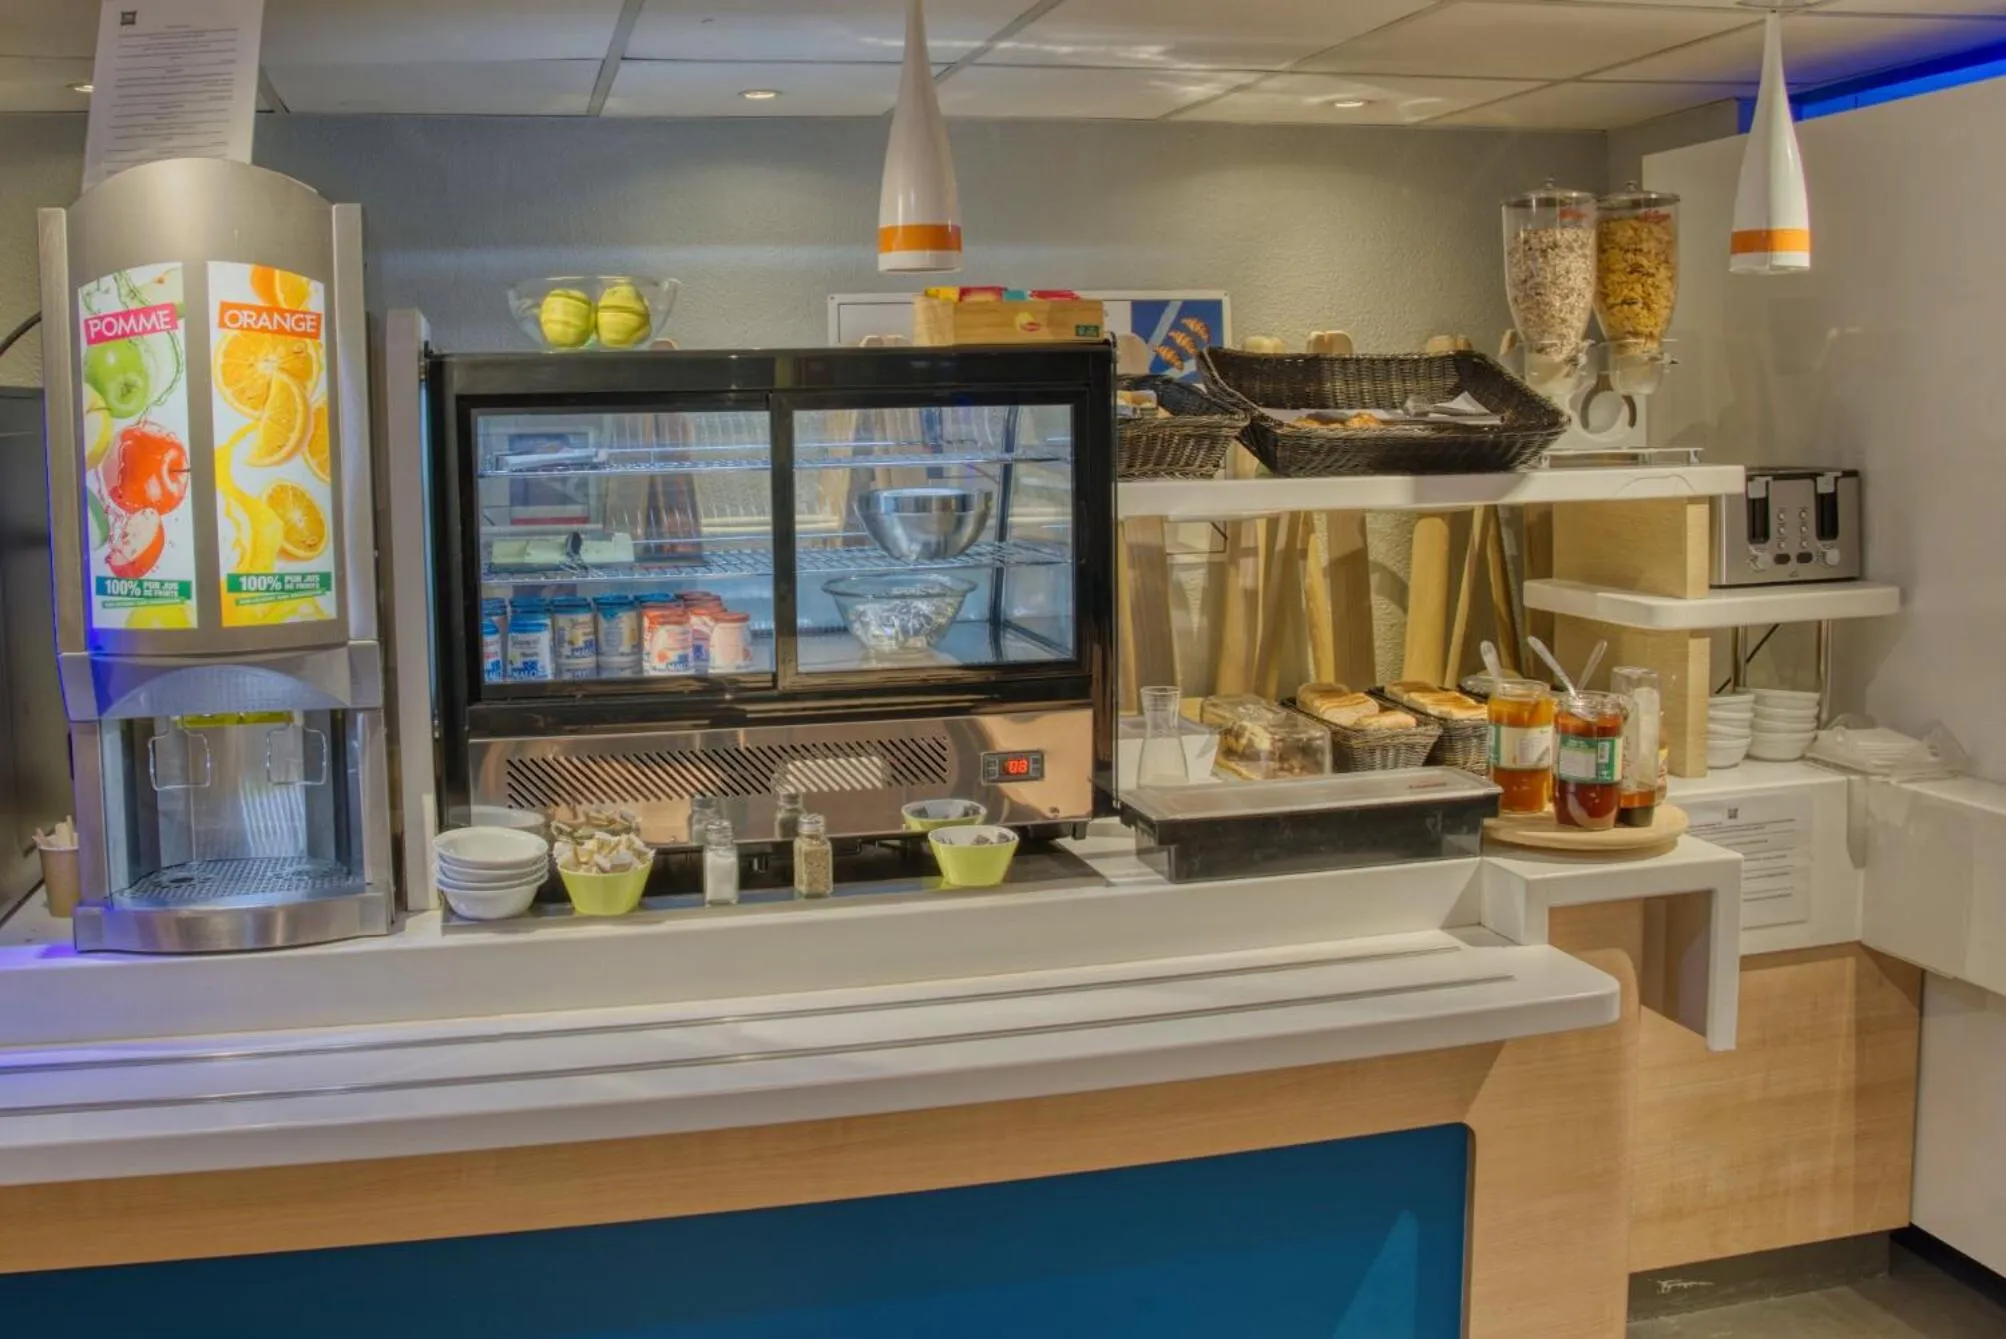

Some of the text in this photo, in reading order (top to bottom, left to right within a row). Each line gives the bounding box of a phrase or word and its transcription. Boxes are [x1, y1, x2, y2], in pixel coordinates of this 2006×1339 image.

[88, 310, 172, 338] POMME
[224, 309, 316, 333] ORANGE
[105, 579, 141, 596] 100%
[239, 575, 282, 591] 100%
